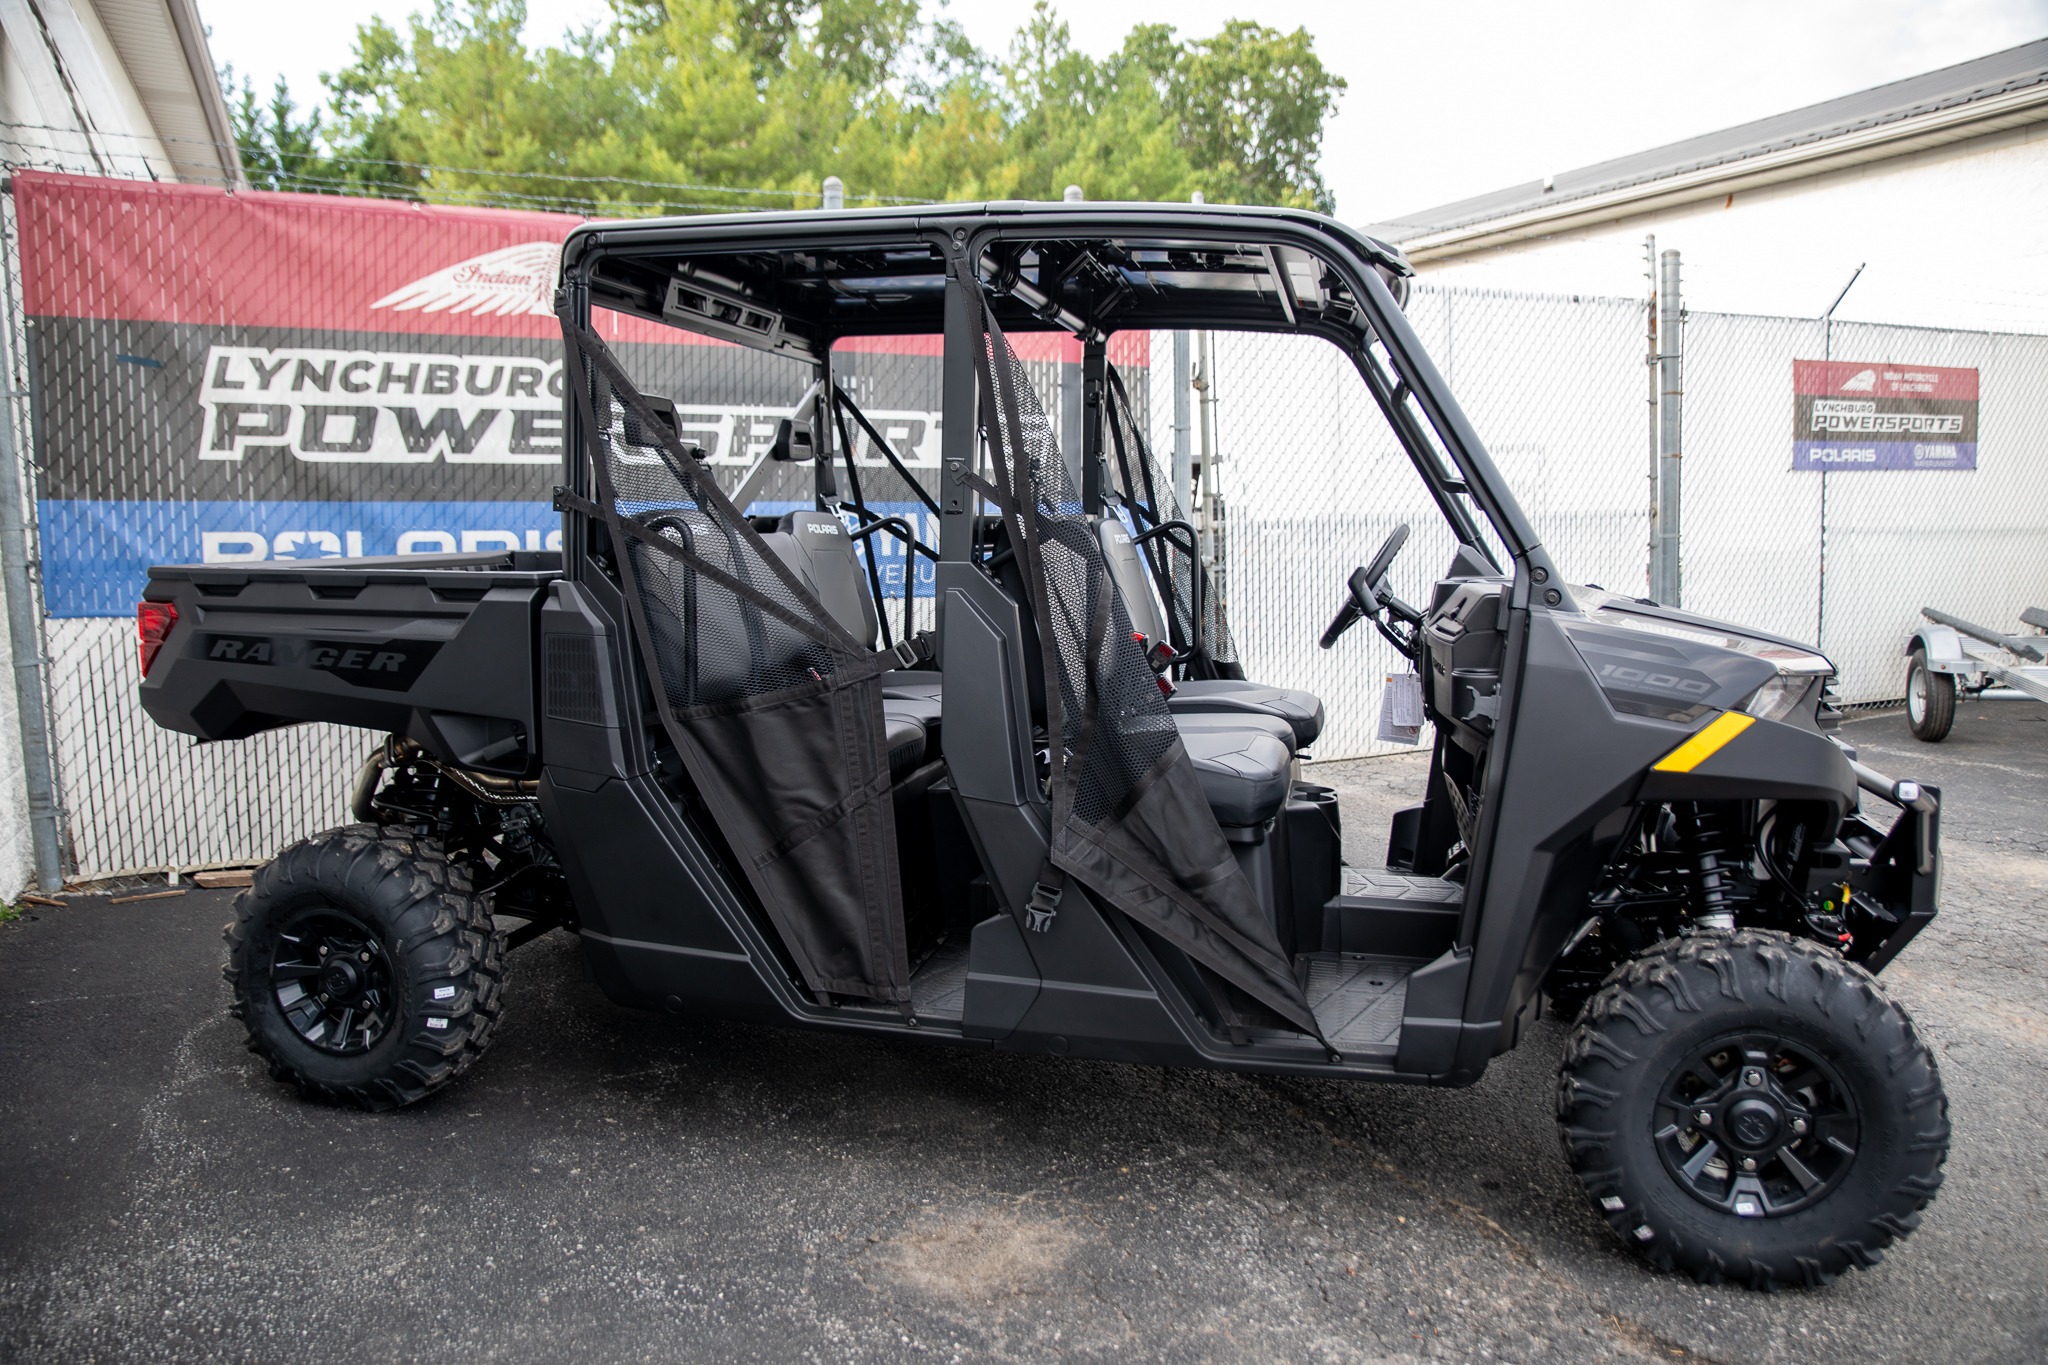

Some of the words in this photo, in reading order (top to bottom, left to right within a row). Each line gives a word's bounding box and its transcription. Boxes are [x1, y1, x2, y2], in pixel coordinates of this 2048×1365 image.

[453, 263, 531, 285] Indian
[212, 356, 562, 397] LYNCHBUR
[1814, 402, 1874, 413] LYNCHBURG
[1813, 415, 1962, 431] POWERSPORTS
[1810, 449, 1877, 463] POLARIS
[807, 523, 838, 535] POLARIS
[1600, 664, 1712, 694] 1000
